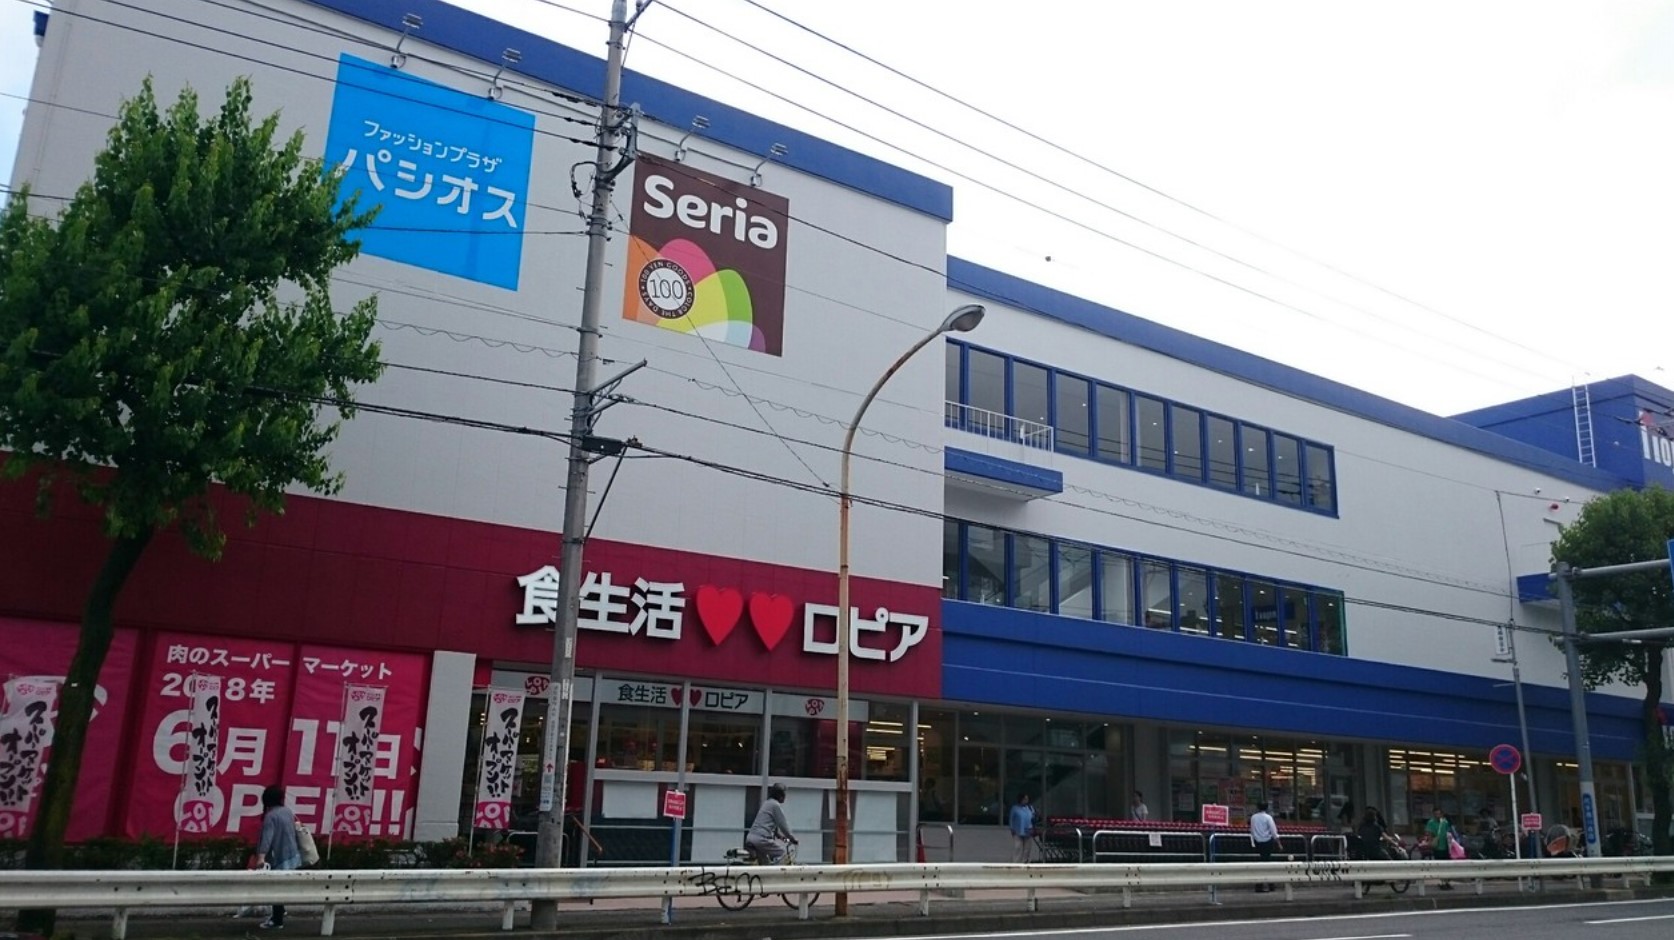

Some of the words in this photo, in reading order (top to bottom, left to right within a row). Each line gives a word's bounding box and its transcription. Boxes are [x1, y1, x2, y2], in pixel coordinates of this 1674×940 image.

[364, 120, 502, 173] ファッションプラザ
[334, 149, 517, 228] パシオス
[643, 175, 778, 249] Seria
[650, 279, 683, 299] 100
[516, 565, 686, 639] 食生活
[803, 602, 929, 662] ロピア
[167, 644, 291, 670] 肉のスーパー
[303, 656, 392, 680] マーケット
[618, 683, 667, 704] 食生活
[705, 691, 749, 710] ロピア
